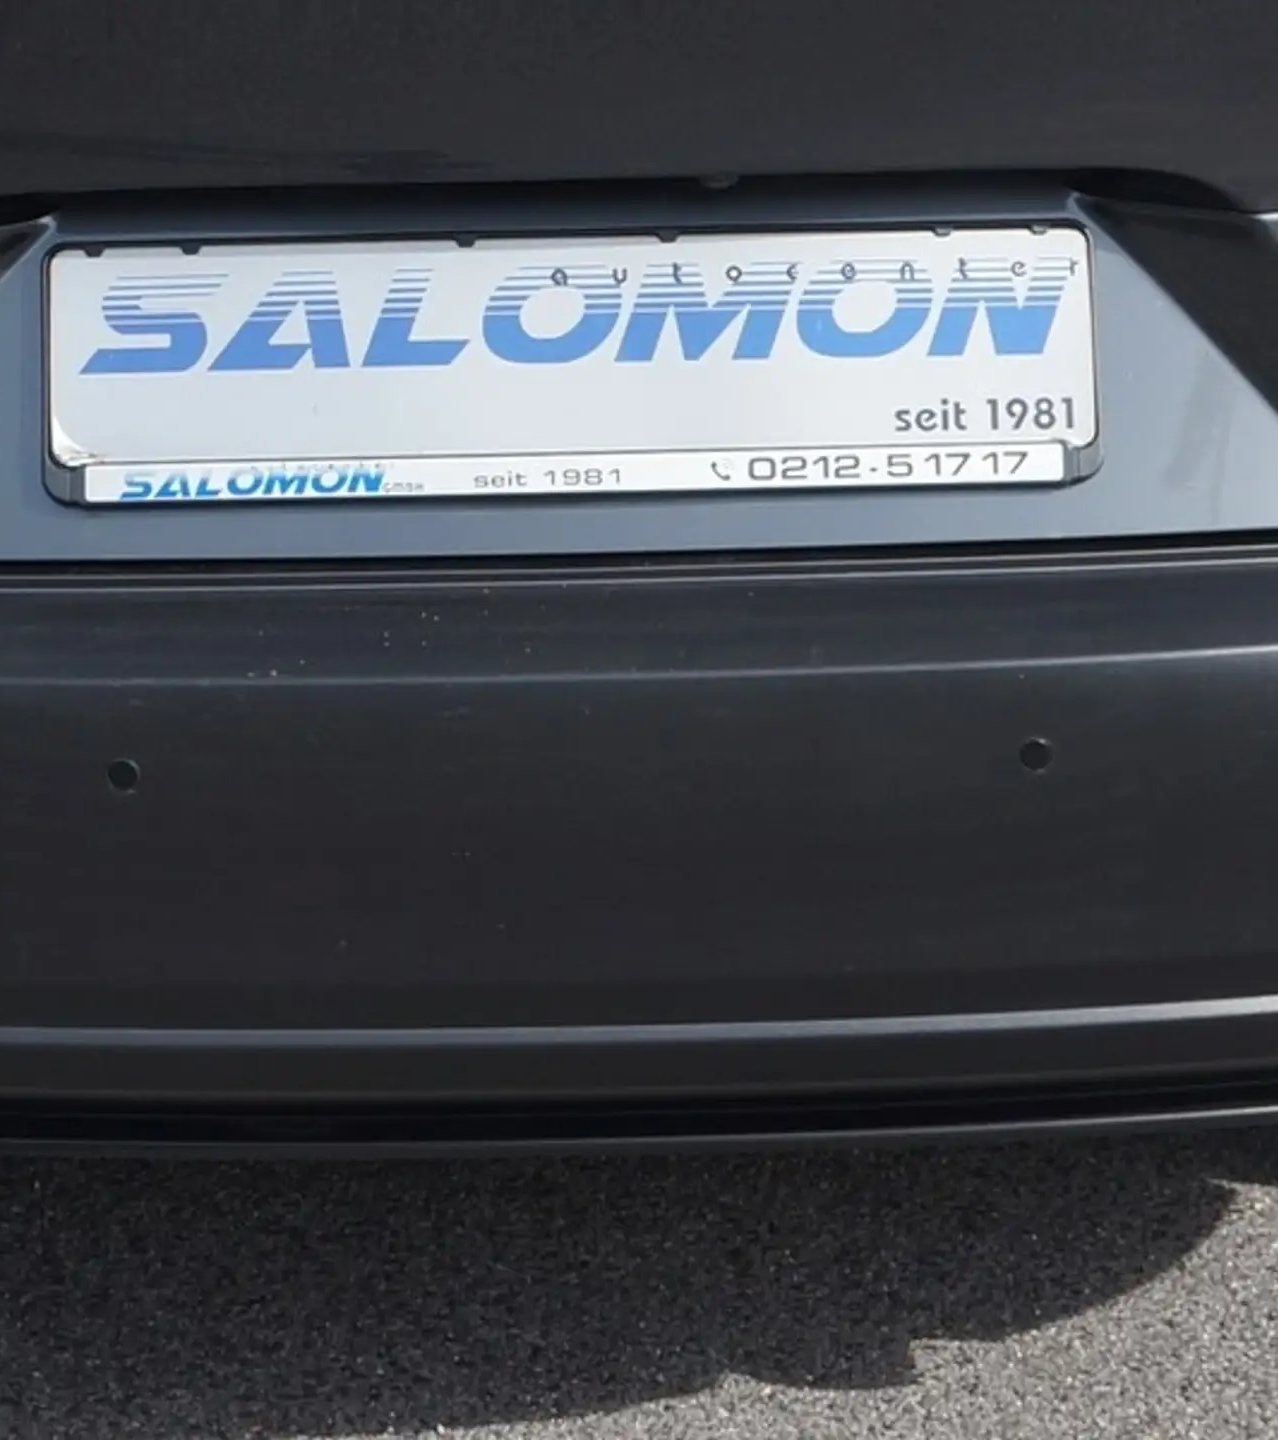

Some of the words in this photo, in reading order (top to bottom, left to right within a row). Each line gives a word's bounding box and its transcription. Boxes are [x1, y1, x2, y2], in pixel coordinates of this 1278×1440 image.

[79, 256, 1073, 375] SALOMON
[893, 398, 967, 432] seit
[985, 396, 1077, 431] 1981
[120, 466, 386, 500] SALOMON
[474, 472, 527, 488] seit
[543, 466, 622, 486] 1981
